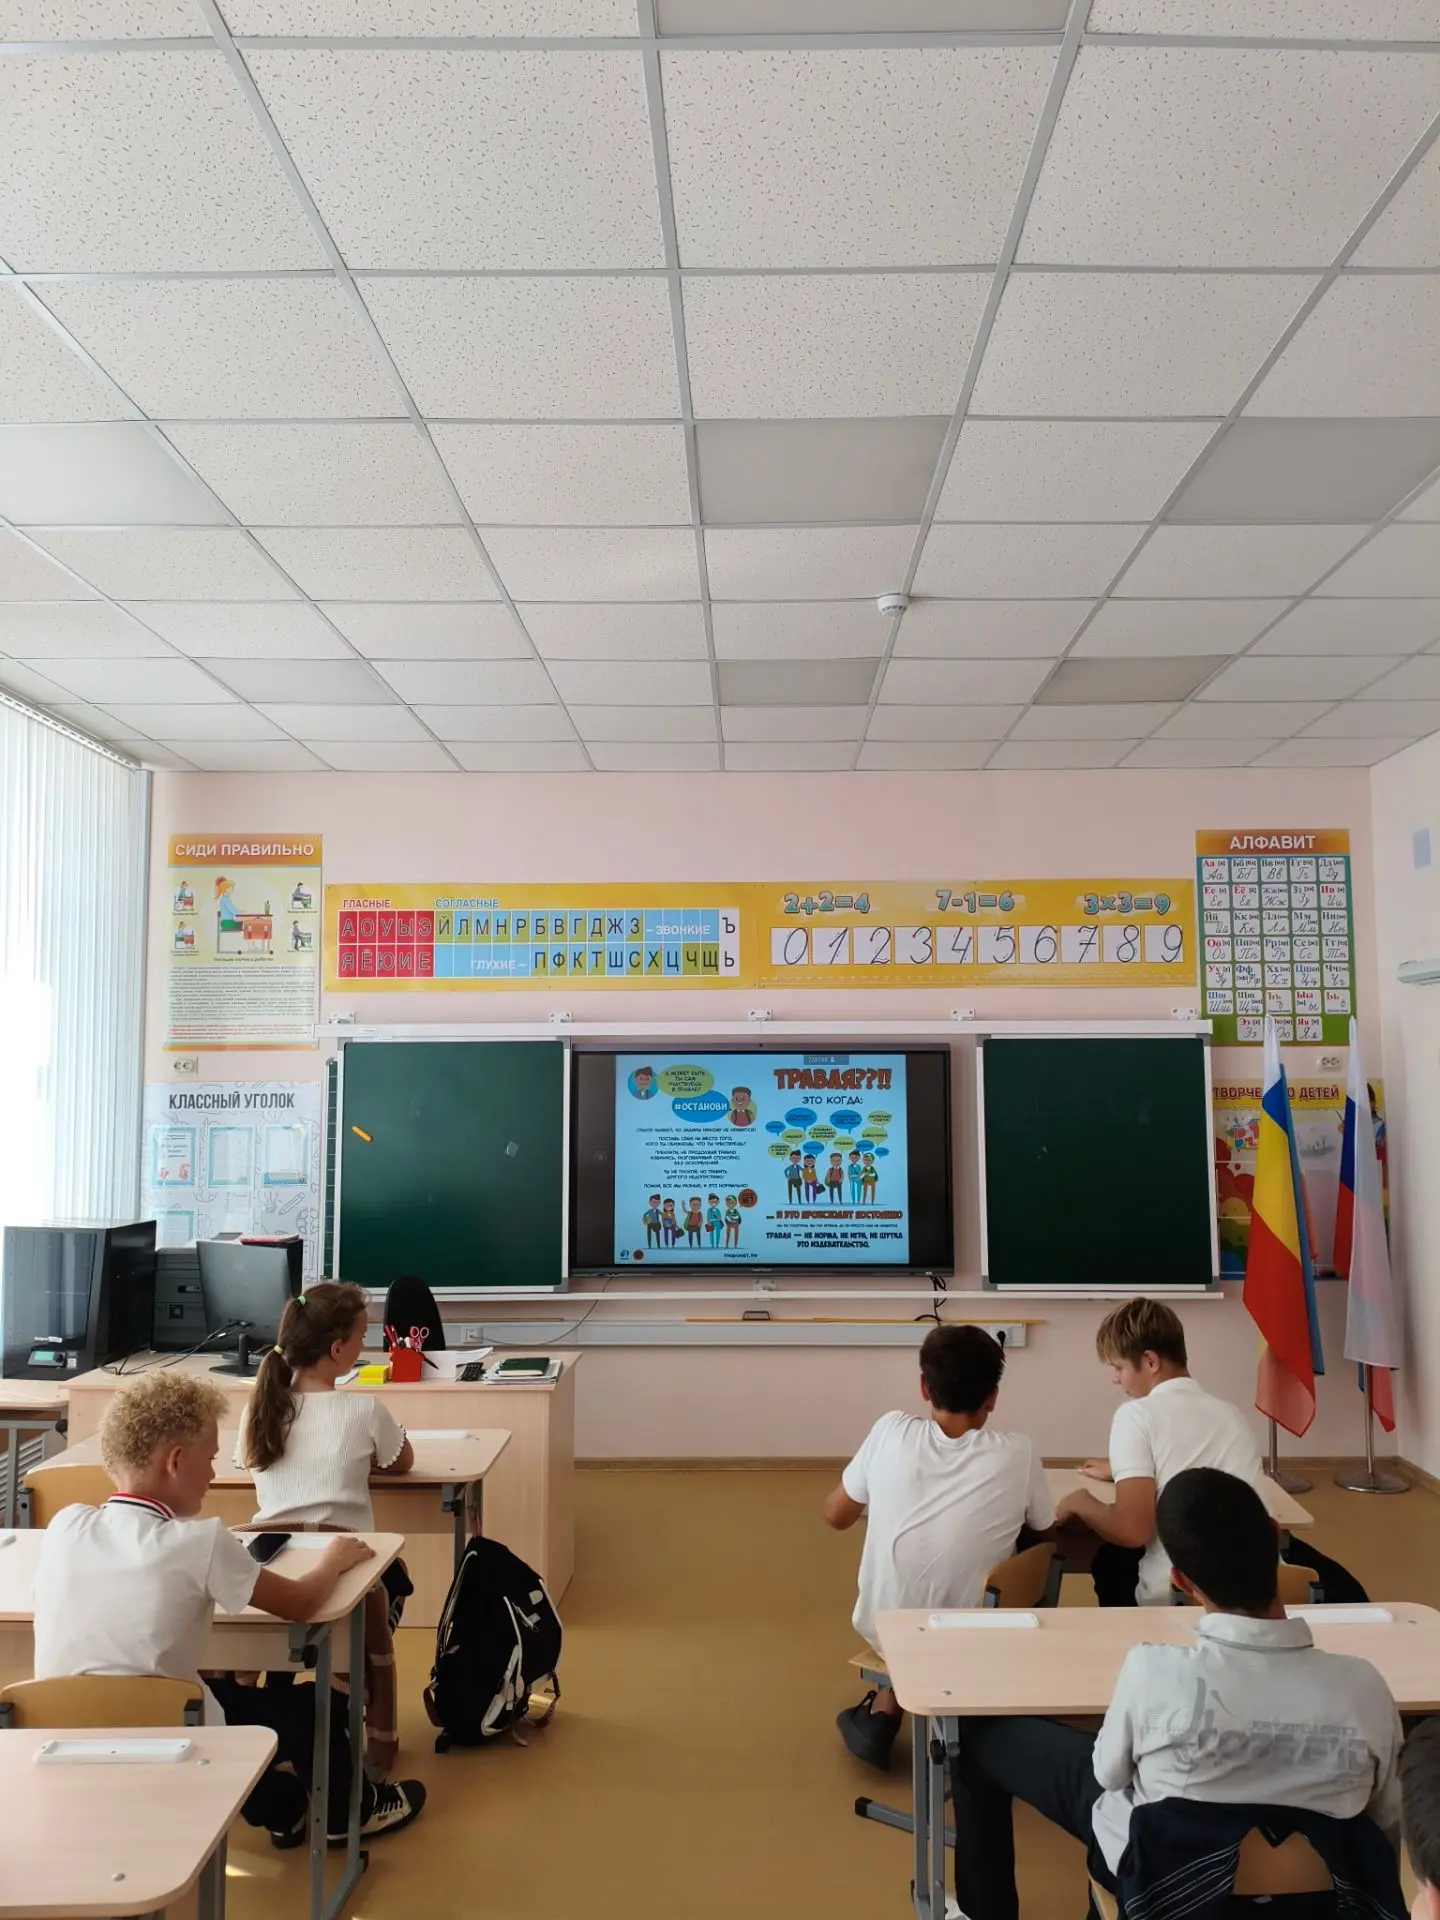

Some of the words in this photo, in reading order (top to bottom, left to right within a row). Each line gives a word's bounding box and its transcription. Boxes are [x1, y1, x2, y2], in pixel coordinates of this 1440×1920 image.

[1230, 836, 1316, 849] АЛФАВИТ
[175, 844, 217, 857] СИДИ
[221, 844, 314, 856] ПРАВИЛЬНО
[343, 899, 391, 908] ГЛАСНЫЕ
[435, 899, 499, 908] СОГЛАСНЫЕ
[784, 891, 870, 914] 2+2=4
[936, 889, 1015, 913] 7-1=6
[656, 925, 710, 935] ЗВОНКИЕ
[722, 918, 735, 933] Ъ
[784, 927, 808, 965] 0
[829, 927, 849, 964] 1
[870, 926, 891, 964] 2
[910, 926, 933, 964] 3
[952, 926, 972, 964] 4
[993, 925, 1016, 963] 5
[1034, 925, 1058, 963] 6
[1078, 925, 1099, 963] 7
[1117, 925, 1140, 962] 8
[1161, 925, 1183, 962] 9
[471, 961, 516, 970] ГЛУХИЕ
[724, 951, 735, 967] Ь
[1213, 1087, 1295, 1098] ТВОРЧЕО
[1299, 1085, 1339, 1099] ДЕТЕЙ
[169, 1091, 240, 1109] КЛАССНЫЙ
[244, 1093, 295, 1109] УГОЛОК
[802, 1096, 823, 1104] ЭТО
[826, 1096, 863, 1105] КОГДА:
[674, 1103, 728, 1111] #ОСТАНОВИ
